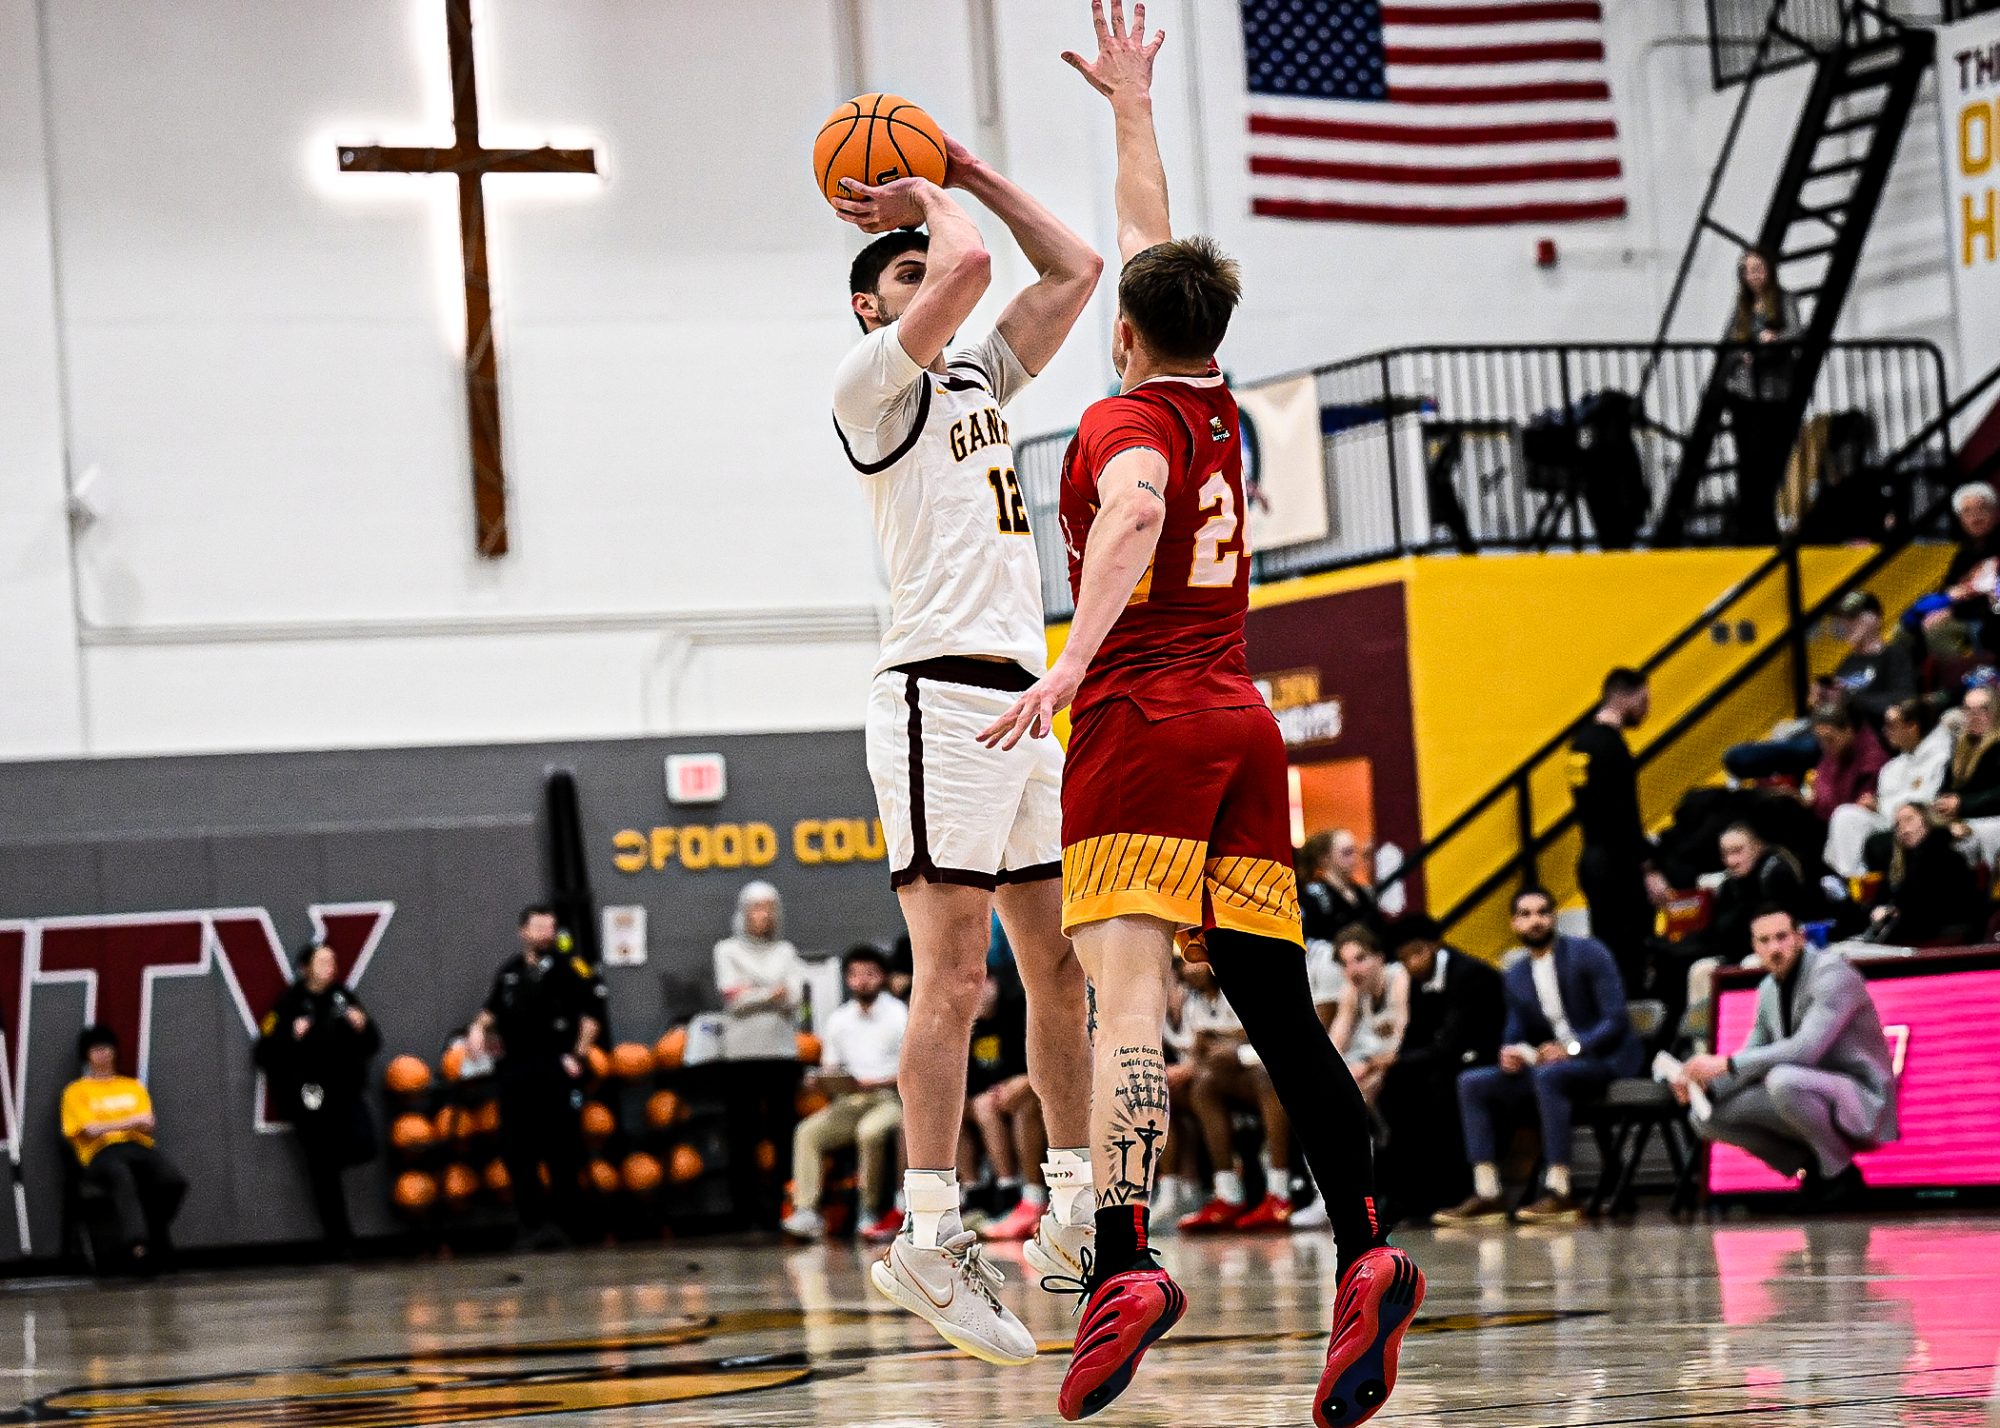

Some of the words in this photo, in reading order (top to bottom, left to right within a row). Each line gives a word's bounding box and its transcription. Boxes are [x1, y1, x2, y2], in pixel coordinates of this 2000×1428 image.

[1955, 44, 2000, 93] TH
[1959, 98, 2000, 177] O
[986, 467, 1031, 535] 12
[1188, 469, 1252, 588] 2
[650, 823, 777, 870] FOOD
[1120, 1046, 1139, 1055] have
[1142, 1045, 1158, 1055] been
